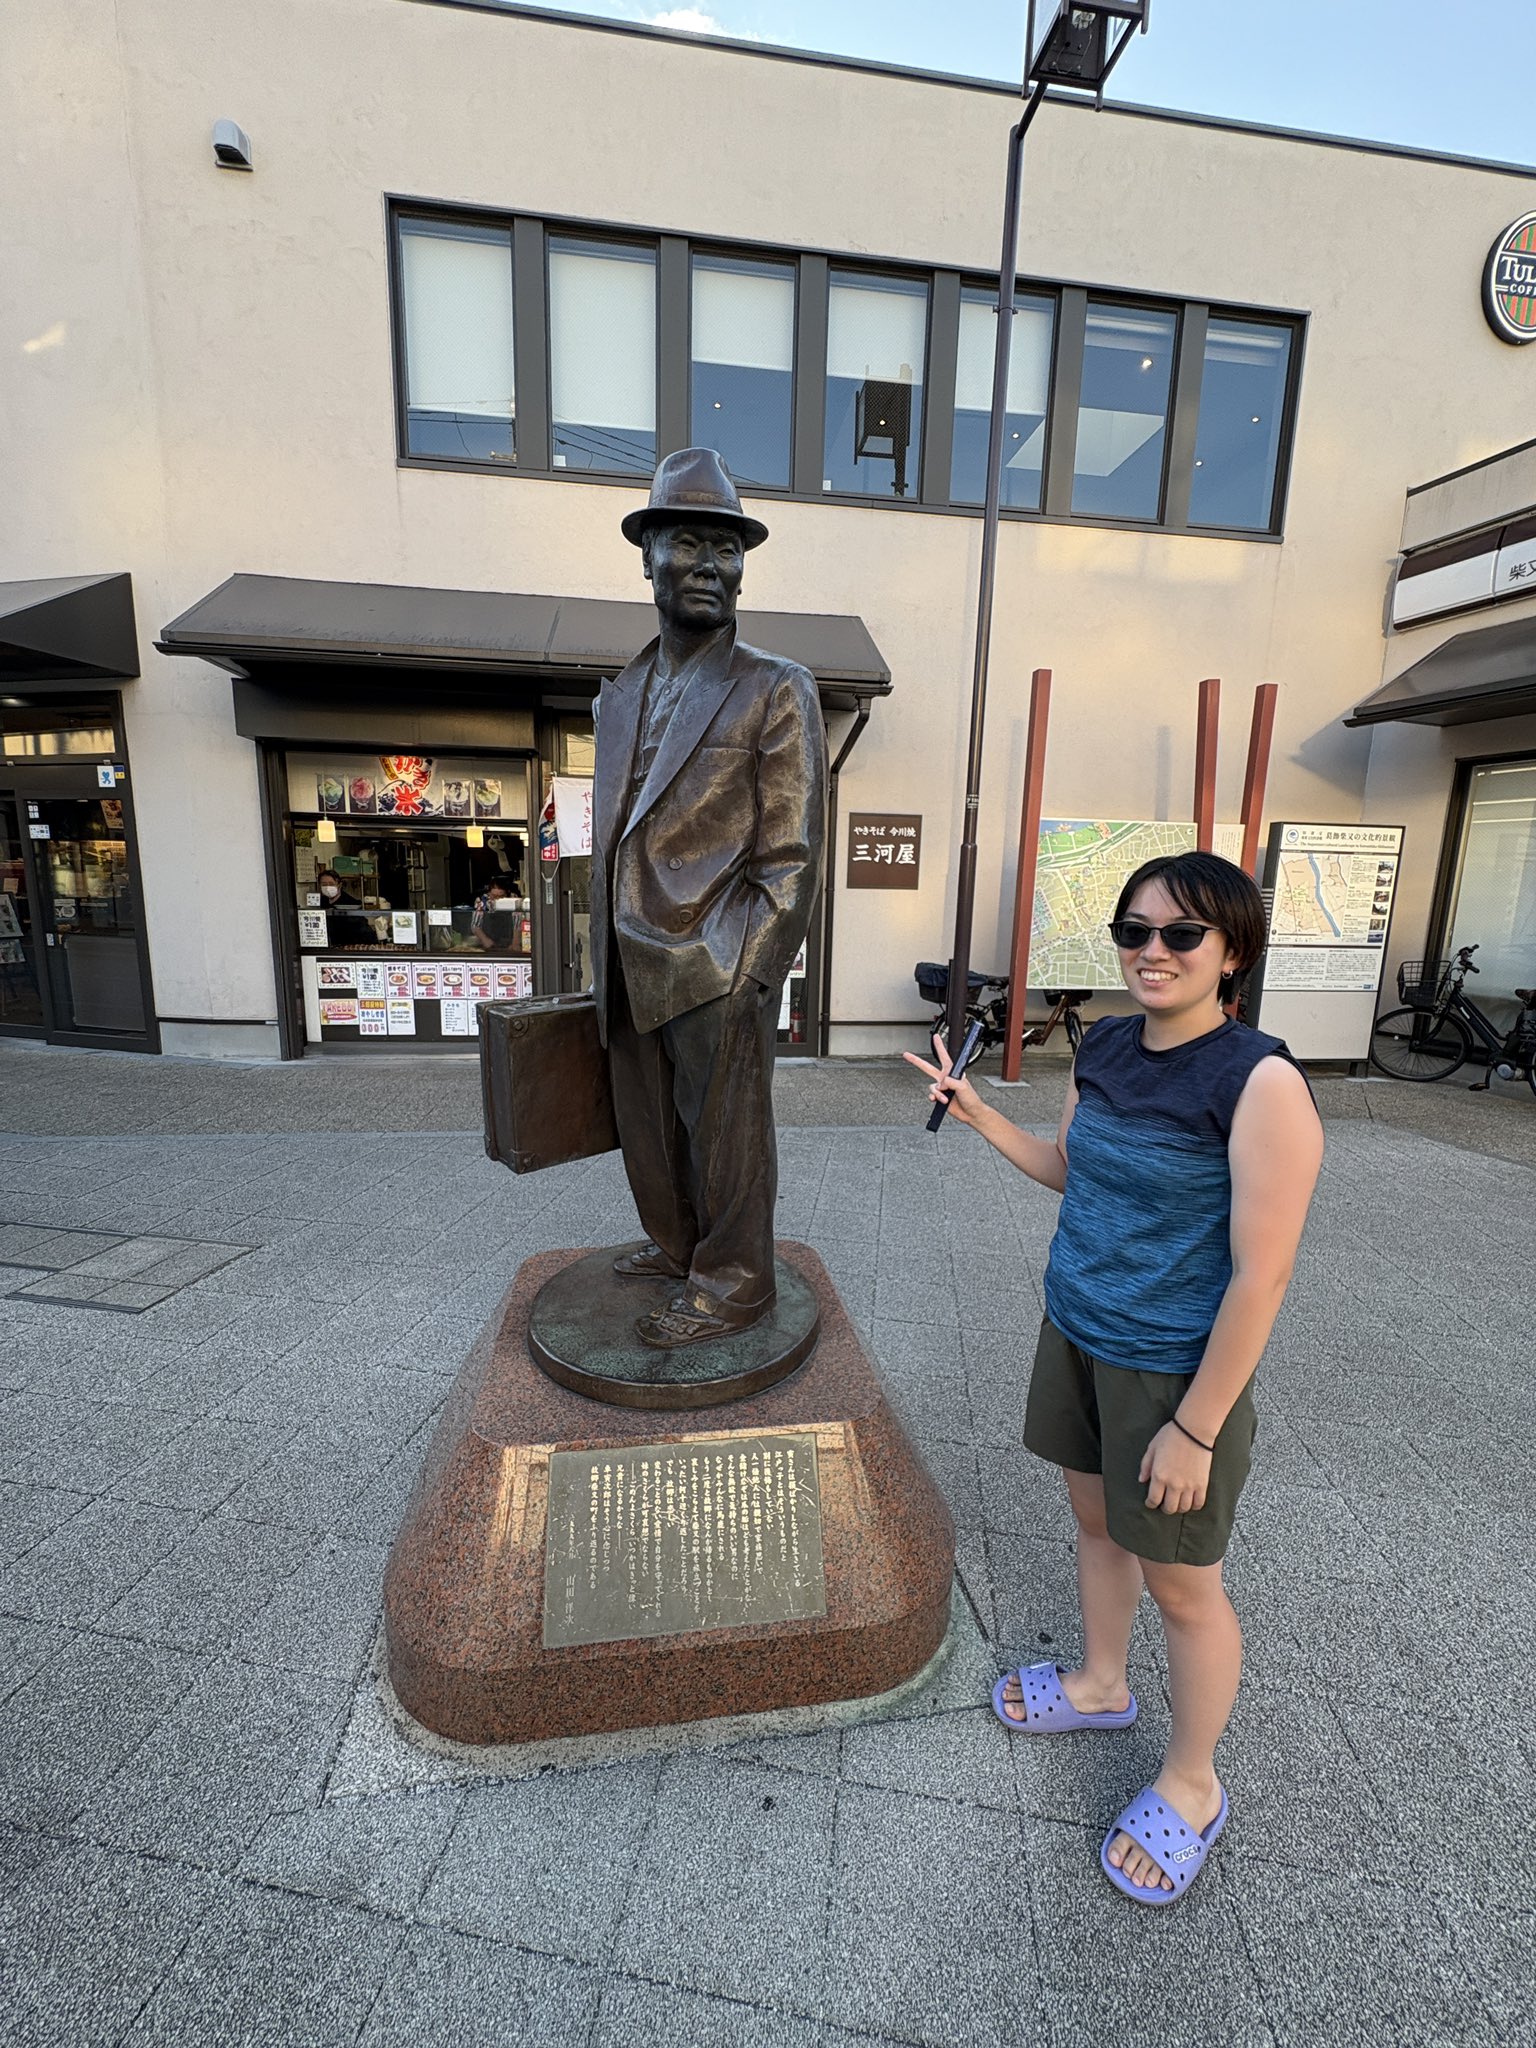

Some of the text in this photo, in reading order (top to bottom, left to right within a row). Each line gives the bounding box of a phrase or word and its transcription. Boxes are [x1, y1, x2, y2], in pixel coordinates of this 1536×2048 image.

[853, 825, 917, 837] やきそば 今川焼
[852, 843, 916, 865] 三河屋
[1174, 1845, 1199, 1862] crocs
